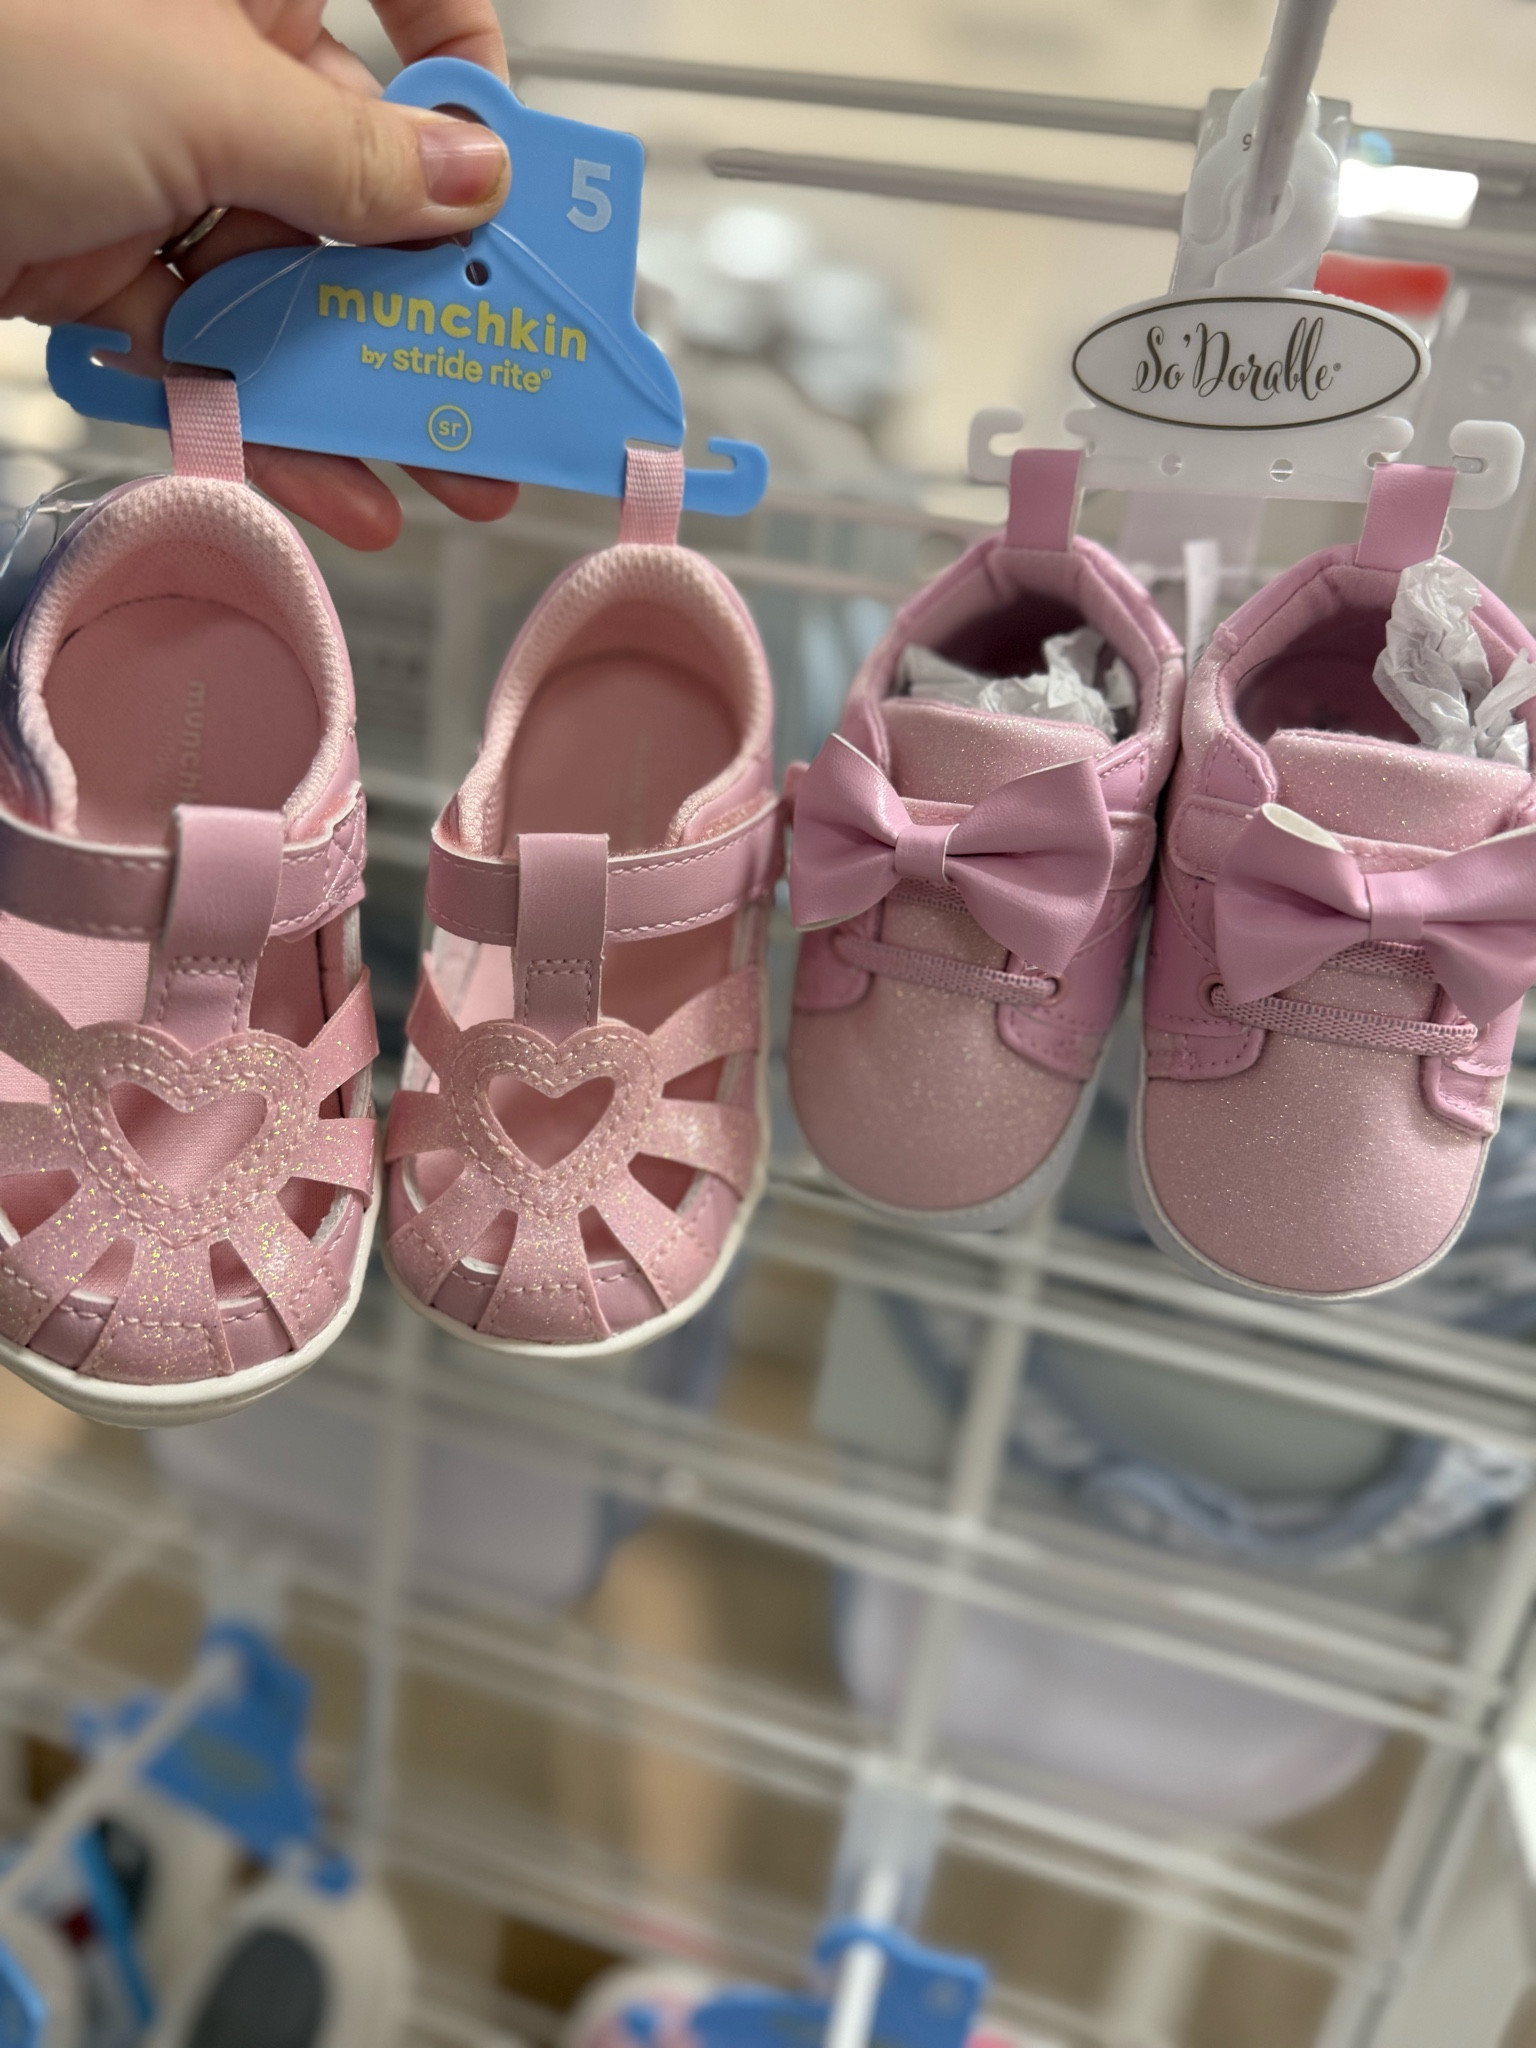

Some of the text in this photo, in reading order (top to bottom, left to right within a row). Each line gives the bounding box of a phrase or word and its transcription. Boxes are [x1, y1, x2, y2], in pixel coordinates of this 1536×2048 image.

[566, 158, 612, 232] 5
[318, 284, 587, 362] munchkin
[361, 343, 387, 369] by
[393, 346, 483, 383] stride
[438, 420, 461, 437] sr
